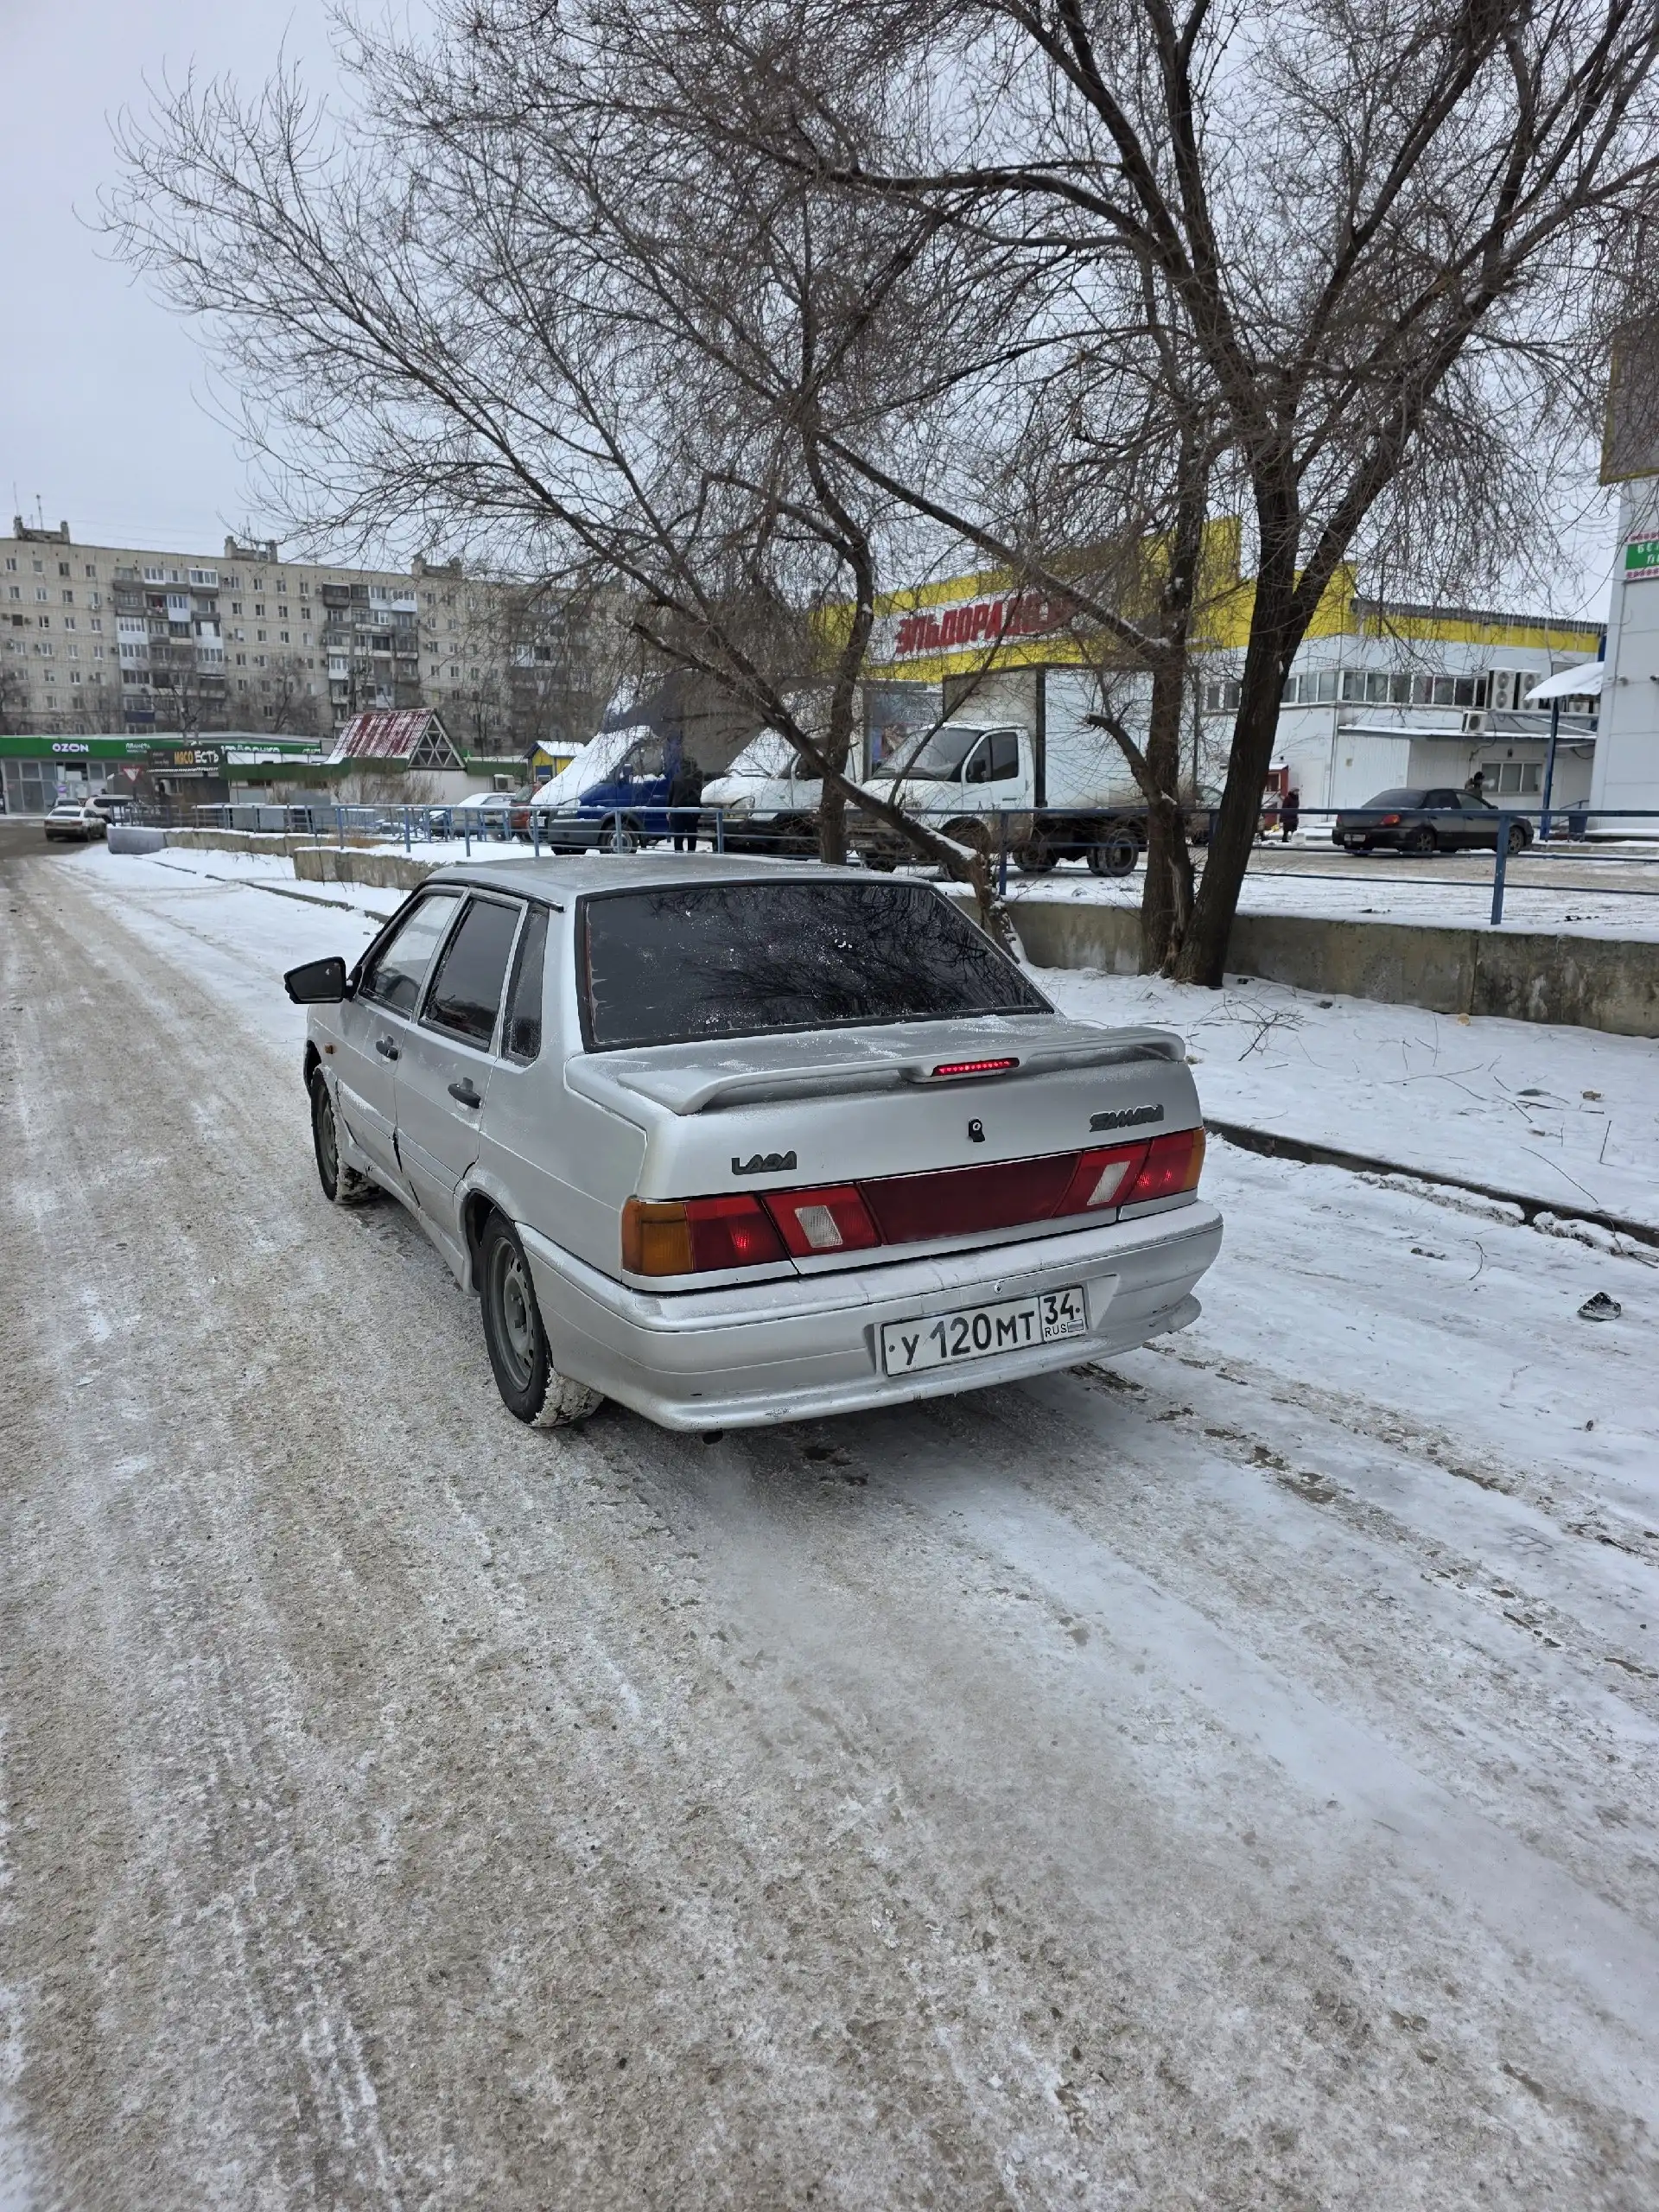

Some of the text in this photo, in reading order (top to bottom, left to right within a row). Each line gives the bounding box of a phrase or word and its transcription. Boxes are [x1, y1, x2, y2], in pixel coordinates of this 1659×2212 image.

[52, 742, 89, 753] OZON
[174, 751, 194, 765] МЯСО
[194, 749, 219, 764] ЕСТЬ
[1089, 1104, 1165, 1133] SAMARA
[731, 1150, 797, 1175] LADA
[1043, 1293, 1074, 1325] 34
[1044, 1325, 1068, 1338] RUS
